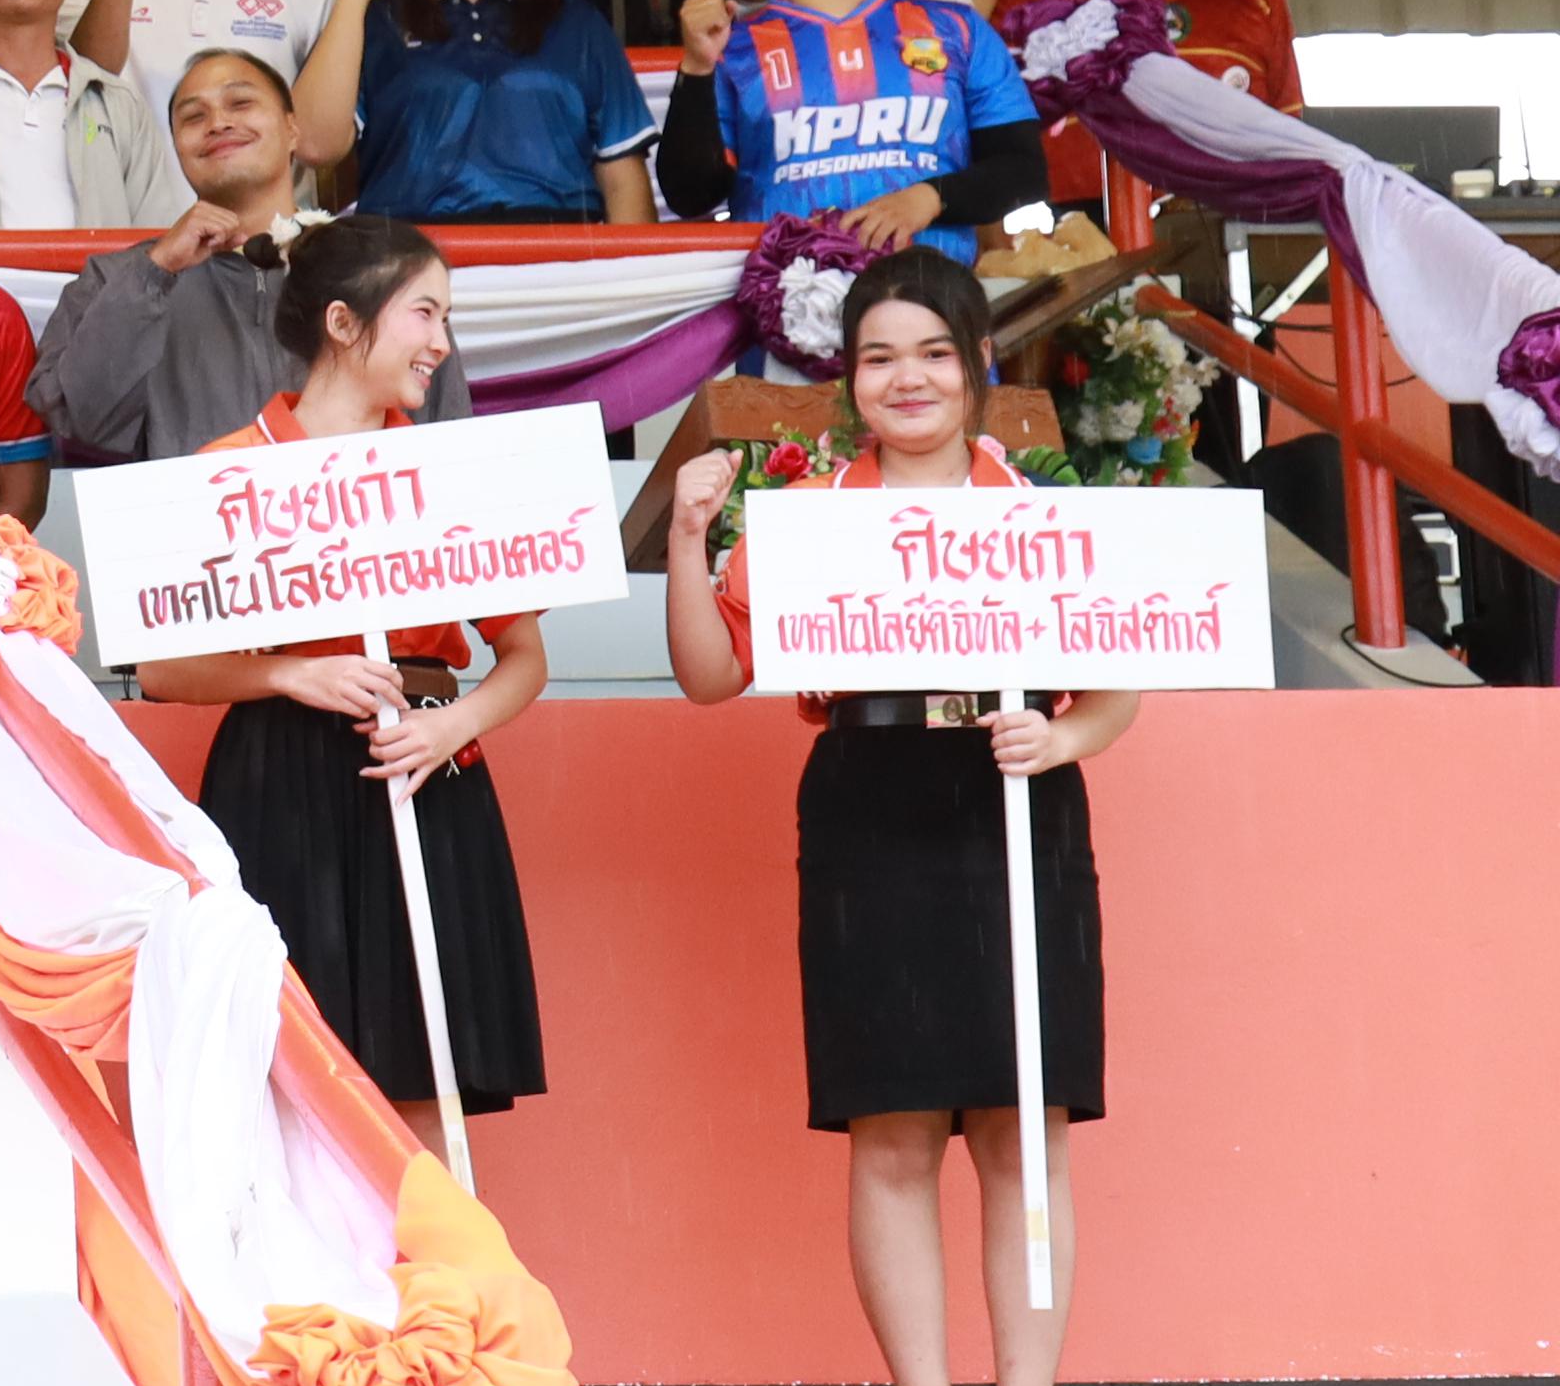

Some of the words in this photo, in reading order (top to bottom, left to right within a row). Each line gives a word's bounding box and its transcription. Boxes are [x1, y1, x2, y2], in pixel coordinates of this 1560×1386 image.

[838, 47, 864, 71] 4
[773, 95, 949, 162] KPRU
[773, 149, 913, 185] PERSONNEL
[914, 152, 938, 172] FC
[209, 445, 425, 544] ศิษย์เก่า
[889, 500, 1096, 584] ศิษย์เก่า
